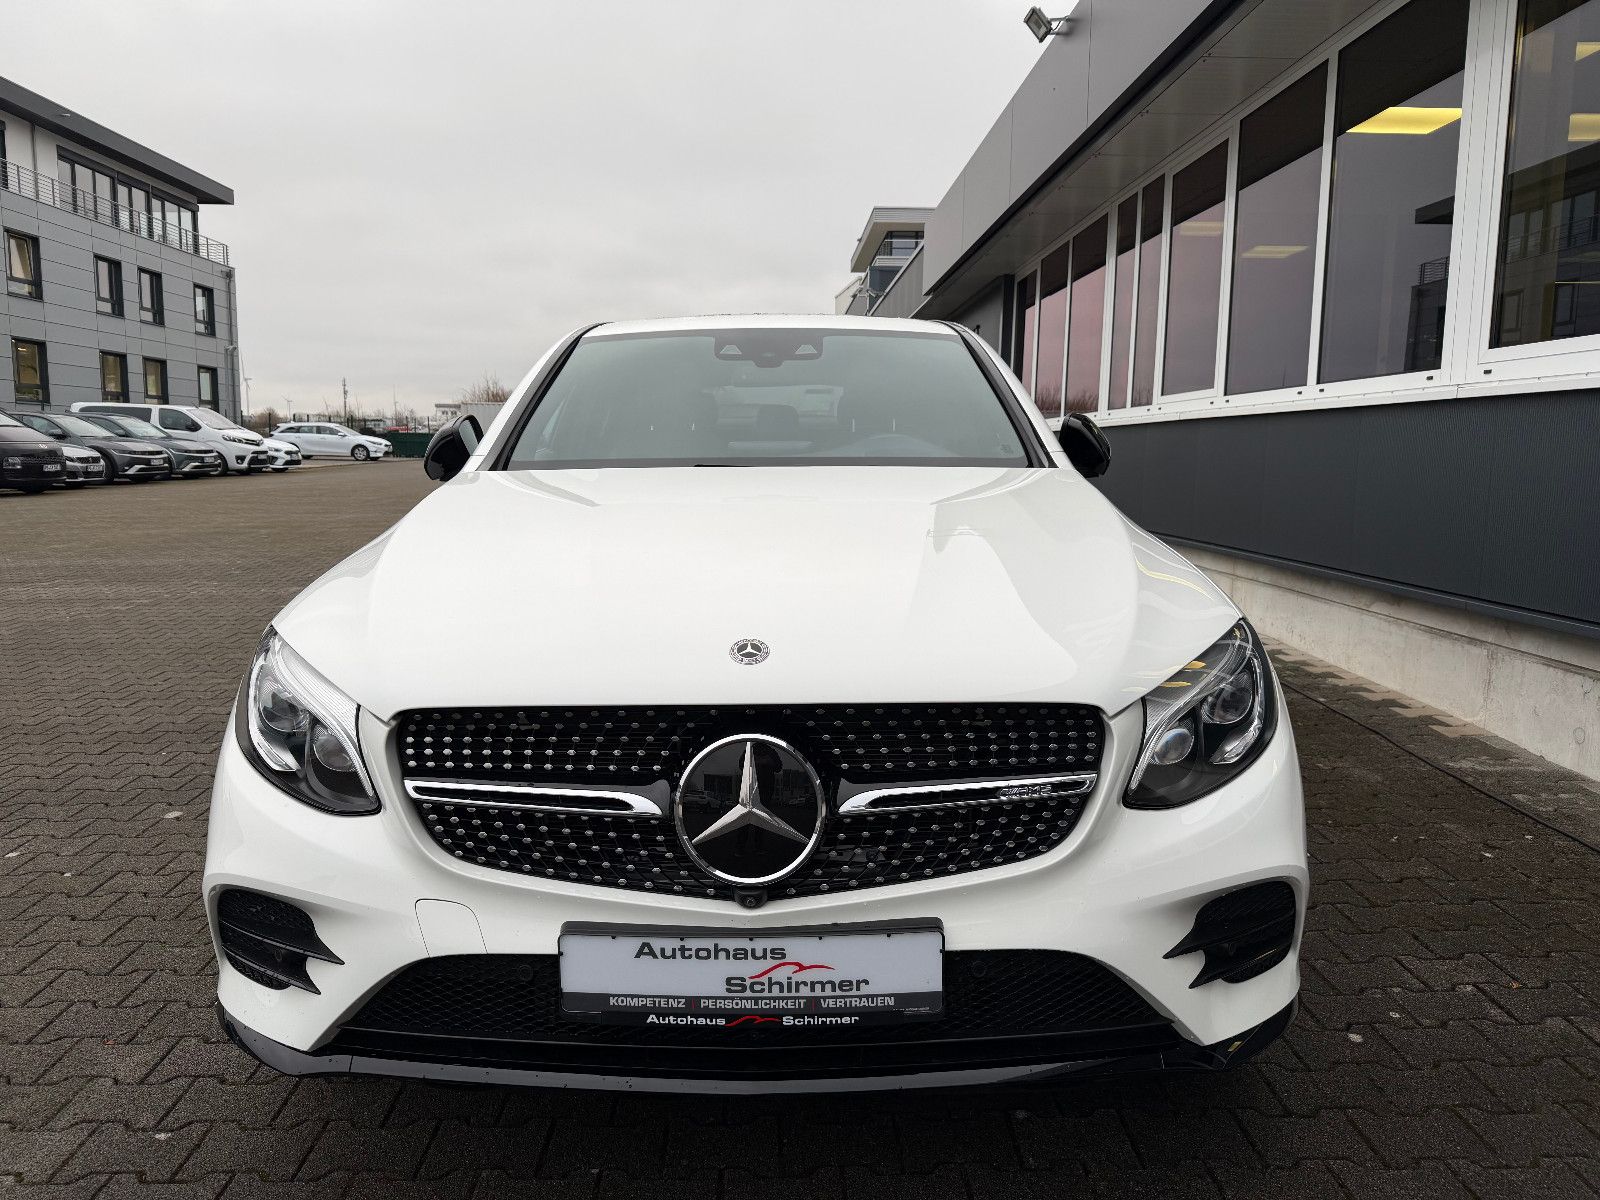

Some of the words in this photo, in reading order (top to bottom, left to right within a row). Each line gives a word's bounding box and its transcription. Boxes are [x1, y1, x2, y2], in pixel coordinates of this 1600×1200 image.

[634, 941, 787, 961] Autohaus
[725, 976, 870, 994] Schirmer
[609, 996, 686, 1008] KOMPETENZ
[700, 997, 807, 1009] PERSÖNLICHKEIT
[820, 996, 895, 1008] VERTRAUEN
[646, 1014, 726, 1026] Autohaus
[782, 1016, 860, 1026] Schirmer
